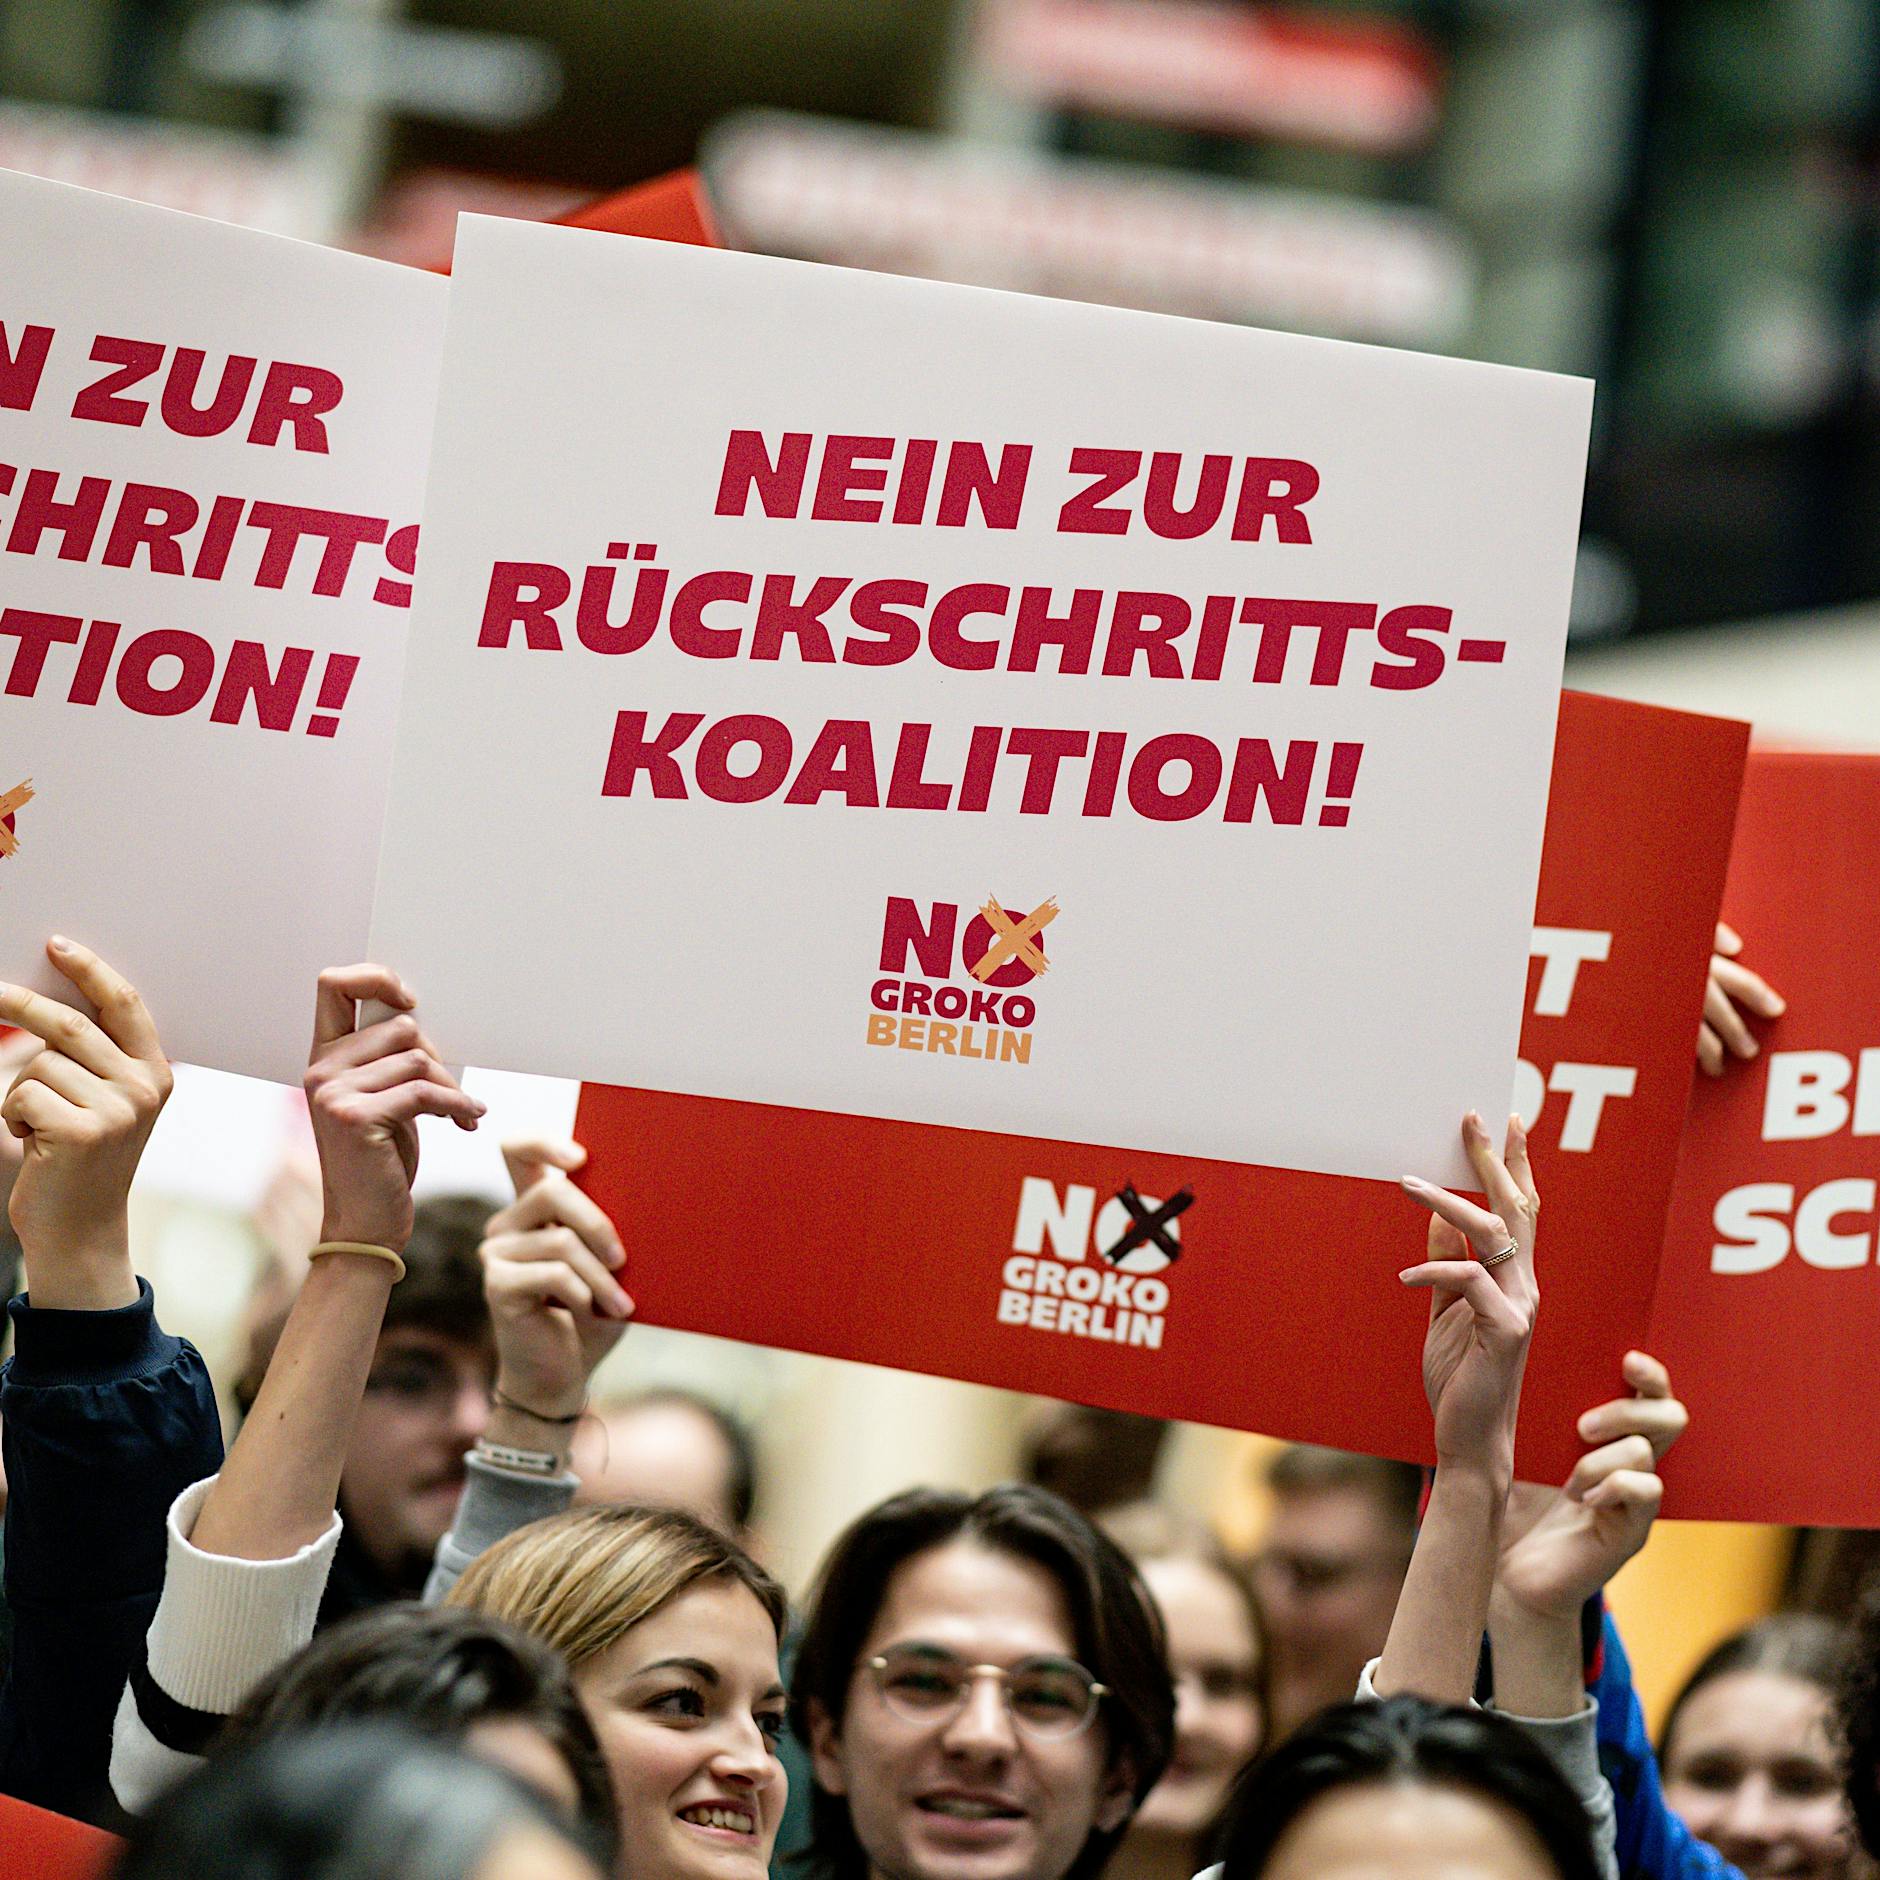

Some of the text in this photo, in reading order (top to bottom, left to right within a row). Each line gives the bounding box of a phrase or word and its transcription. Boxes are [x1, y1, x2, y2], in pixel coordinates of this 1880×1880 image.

[71, 335, 344, 455] ZUR
[715, 429, 1321, 545] NEIN ZUR
[477, 541, 1506, 691] RÜCKSCHRITTS-
[601, 709, 1365, 828] KOALITION!
[880, 895, 1047, 990] NO
[866, 1013, 1033, 1065] BERLIN
[870, 978, 1037, 1029] GROKO
[1012, 1175, 1182, 1274] NO
[997, 1288, 1166, 1350] BERLIN
[1002, 1255, 1170, 1313] GROKO
